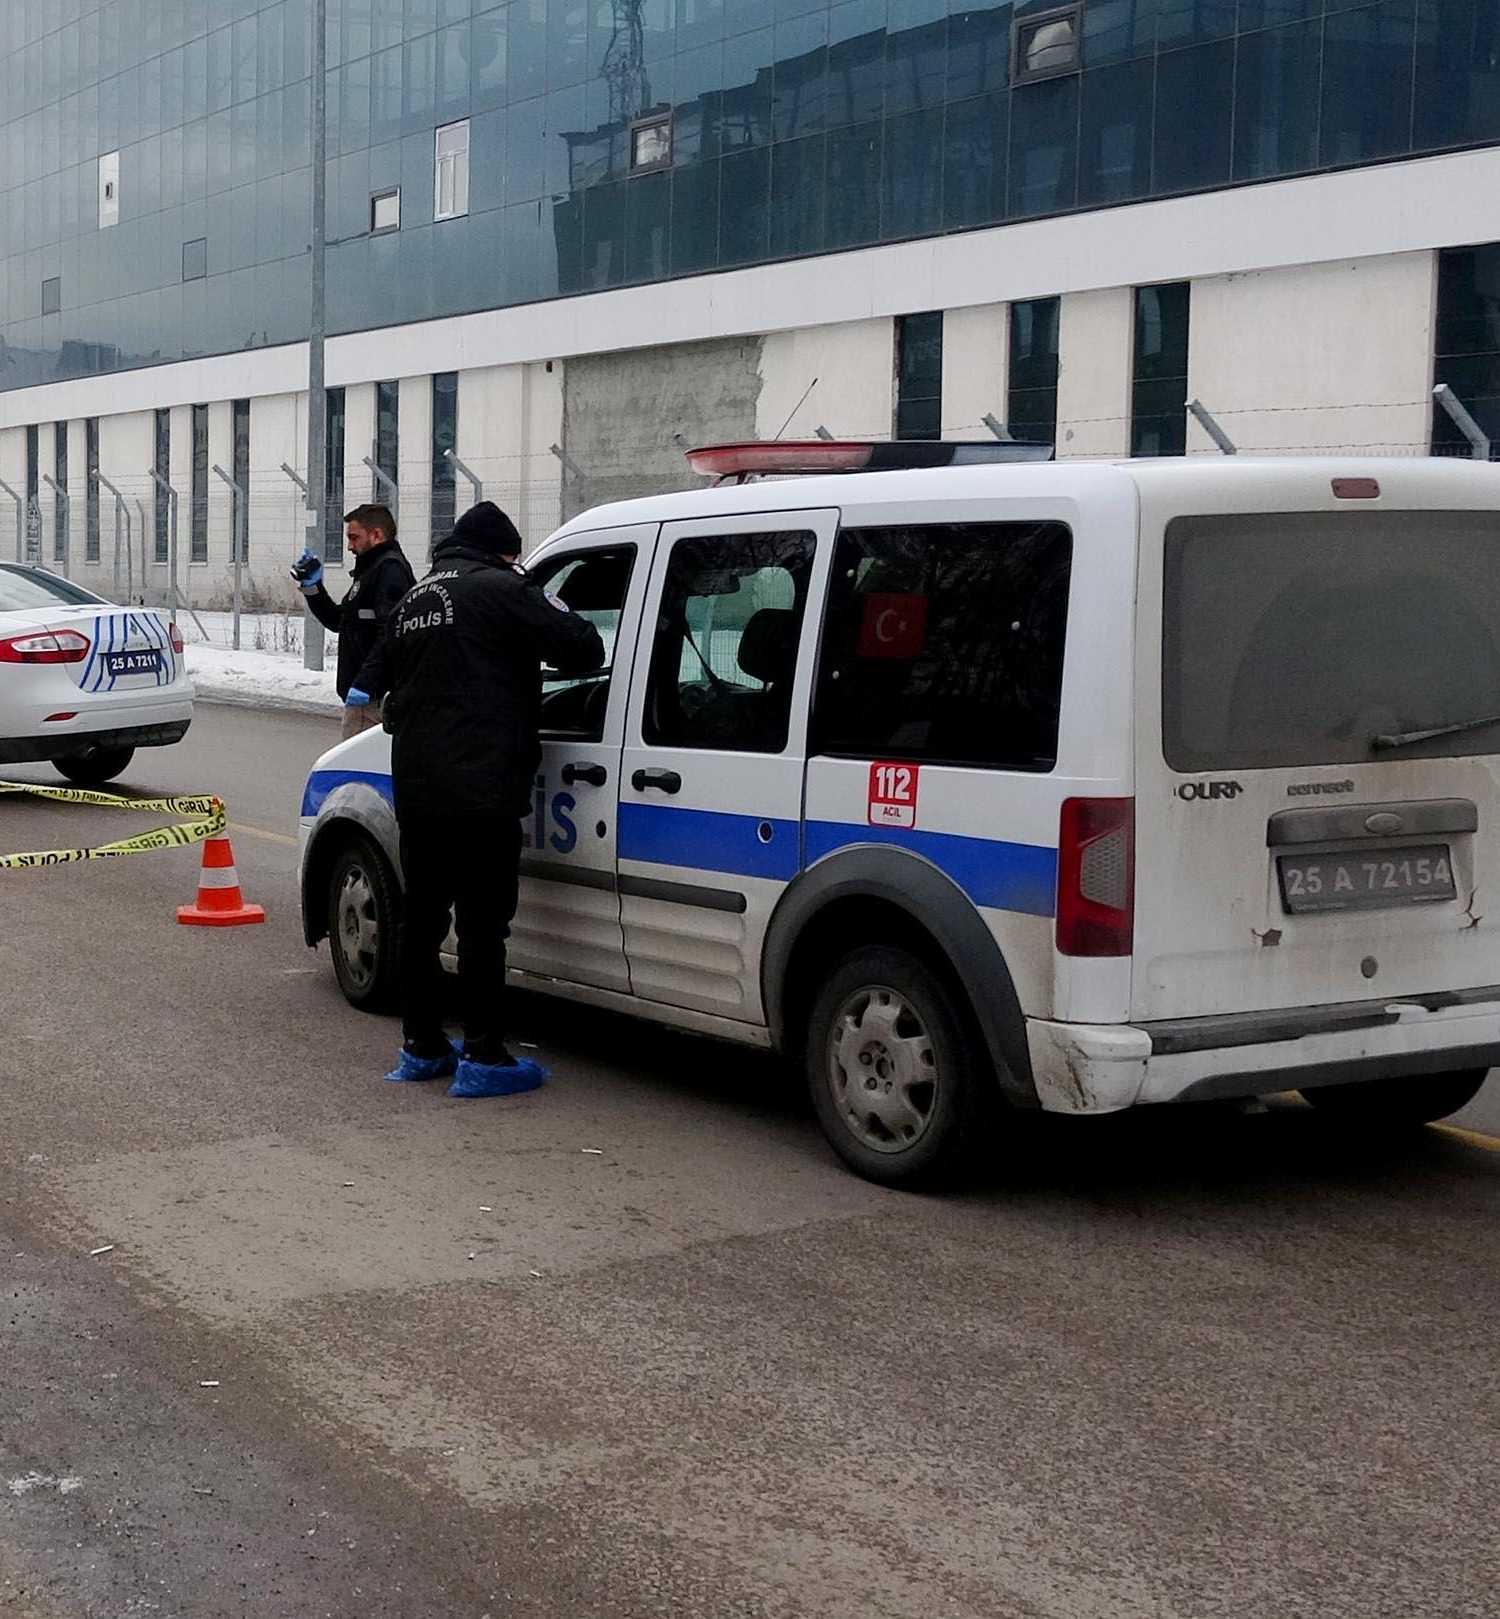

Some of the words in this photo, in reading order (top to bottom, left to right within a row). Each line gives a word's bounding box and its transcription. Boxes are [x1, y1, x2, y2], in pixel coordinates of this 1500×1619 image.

[111, 657, 125, 670] 25
[127, 656, 135, 669] A
[135, 654, 157, 667] 7211
[876, 766, 911, 800] 112
[1287, 866, 1323, 896] 25
[1334, 866, 1355, 892] A
[1361, 858, 1452, 890] 72154
